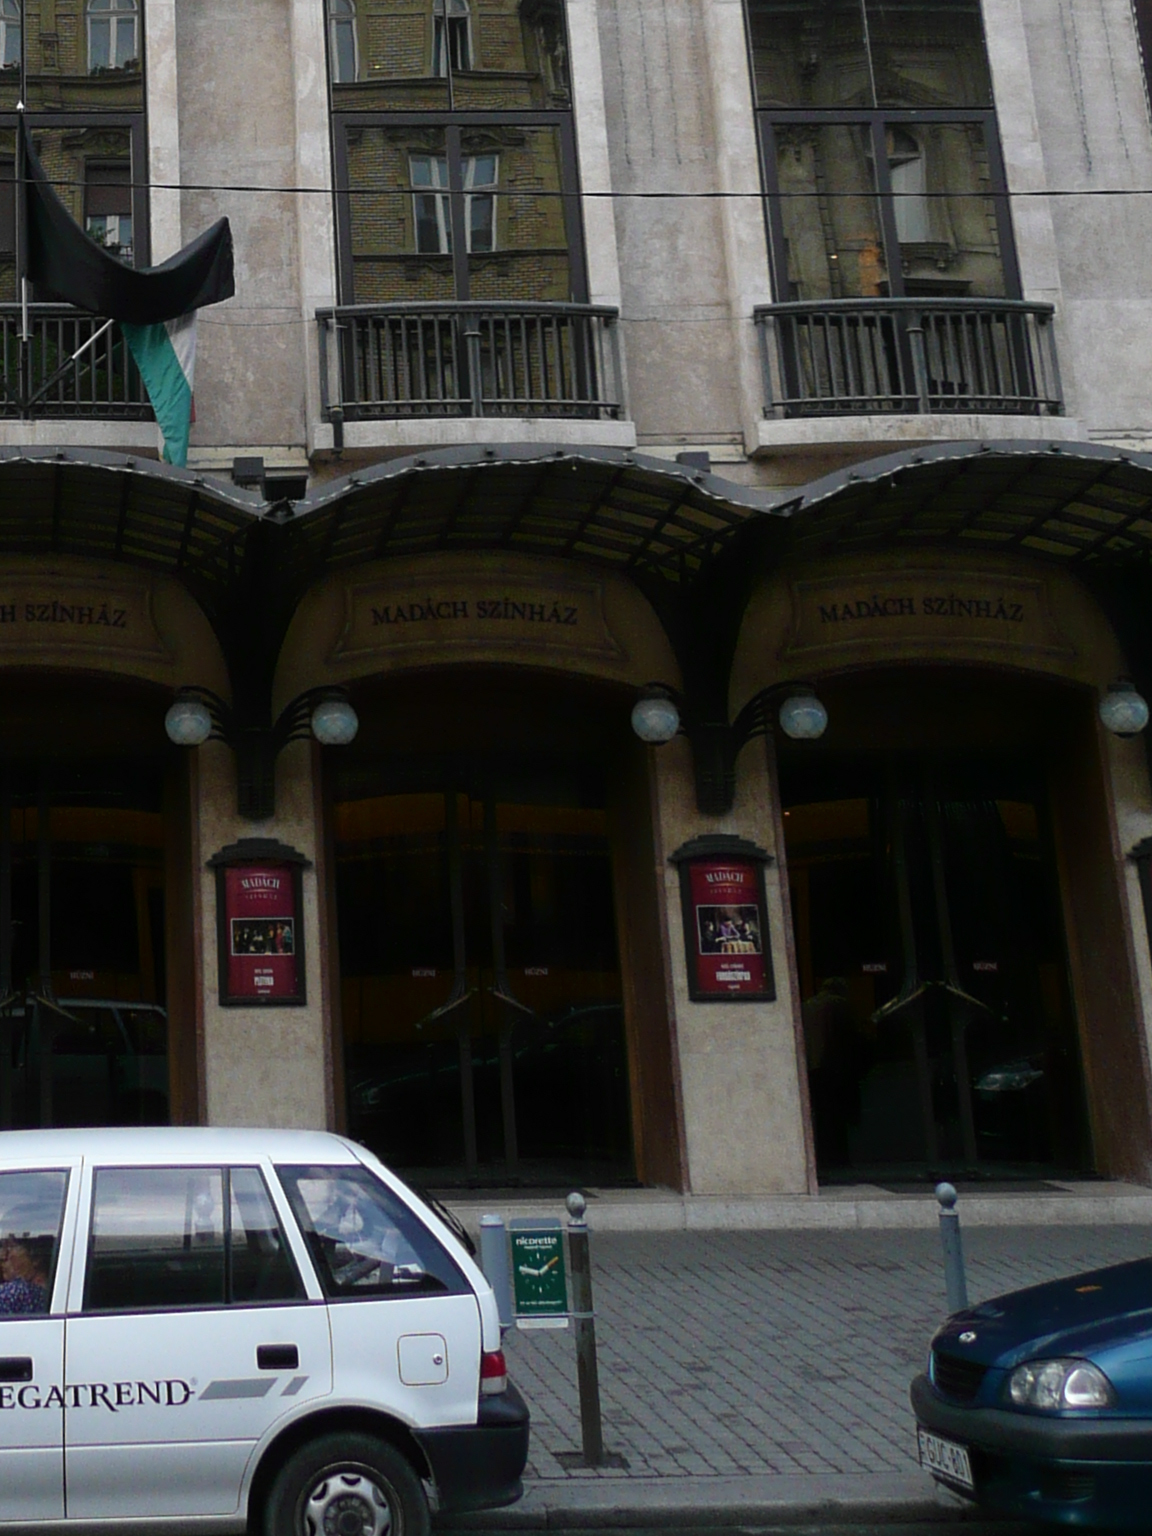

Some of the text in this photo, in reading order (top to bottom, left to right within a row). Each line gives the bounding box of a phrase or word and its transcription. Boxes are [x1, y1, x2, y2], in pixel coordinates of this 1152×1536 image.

[25, 600, 126, 629] SZÍNHÁZ
[371, 596, 579, 627] MADÁCH SZÍNHÁZ
[819, 593, 1025, 623] MADÁCH SZÍNHÁZ
[515, 1236, 558, 1246] nicorette
